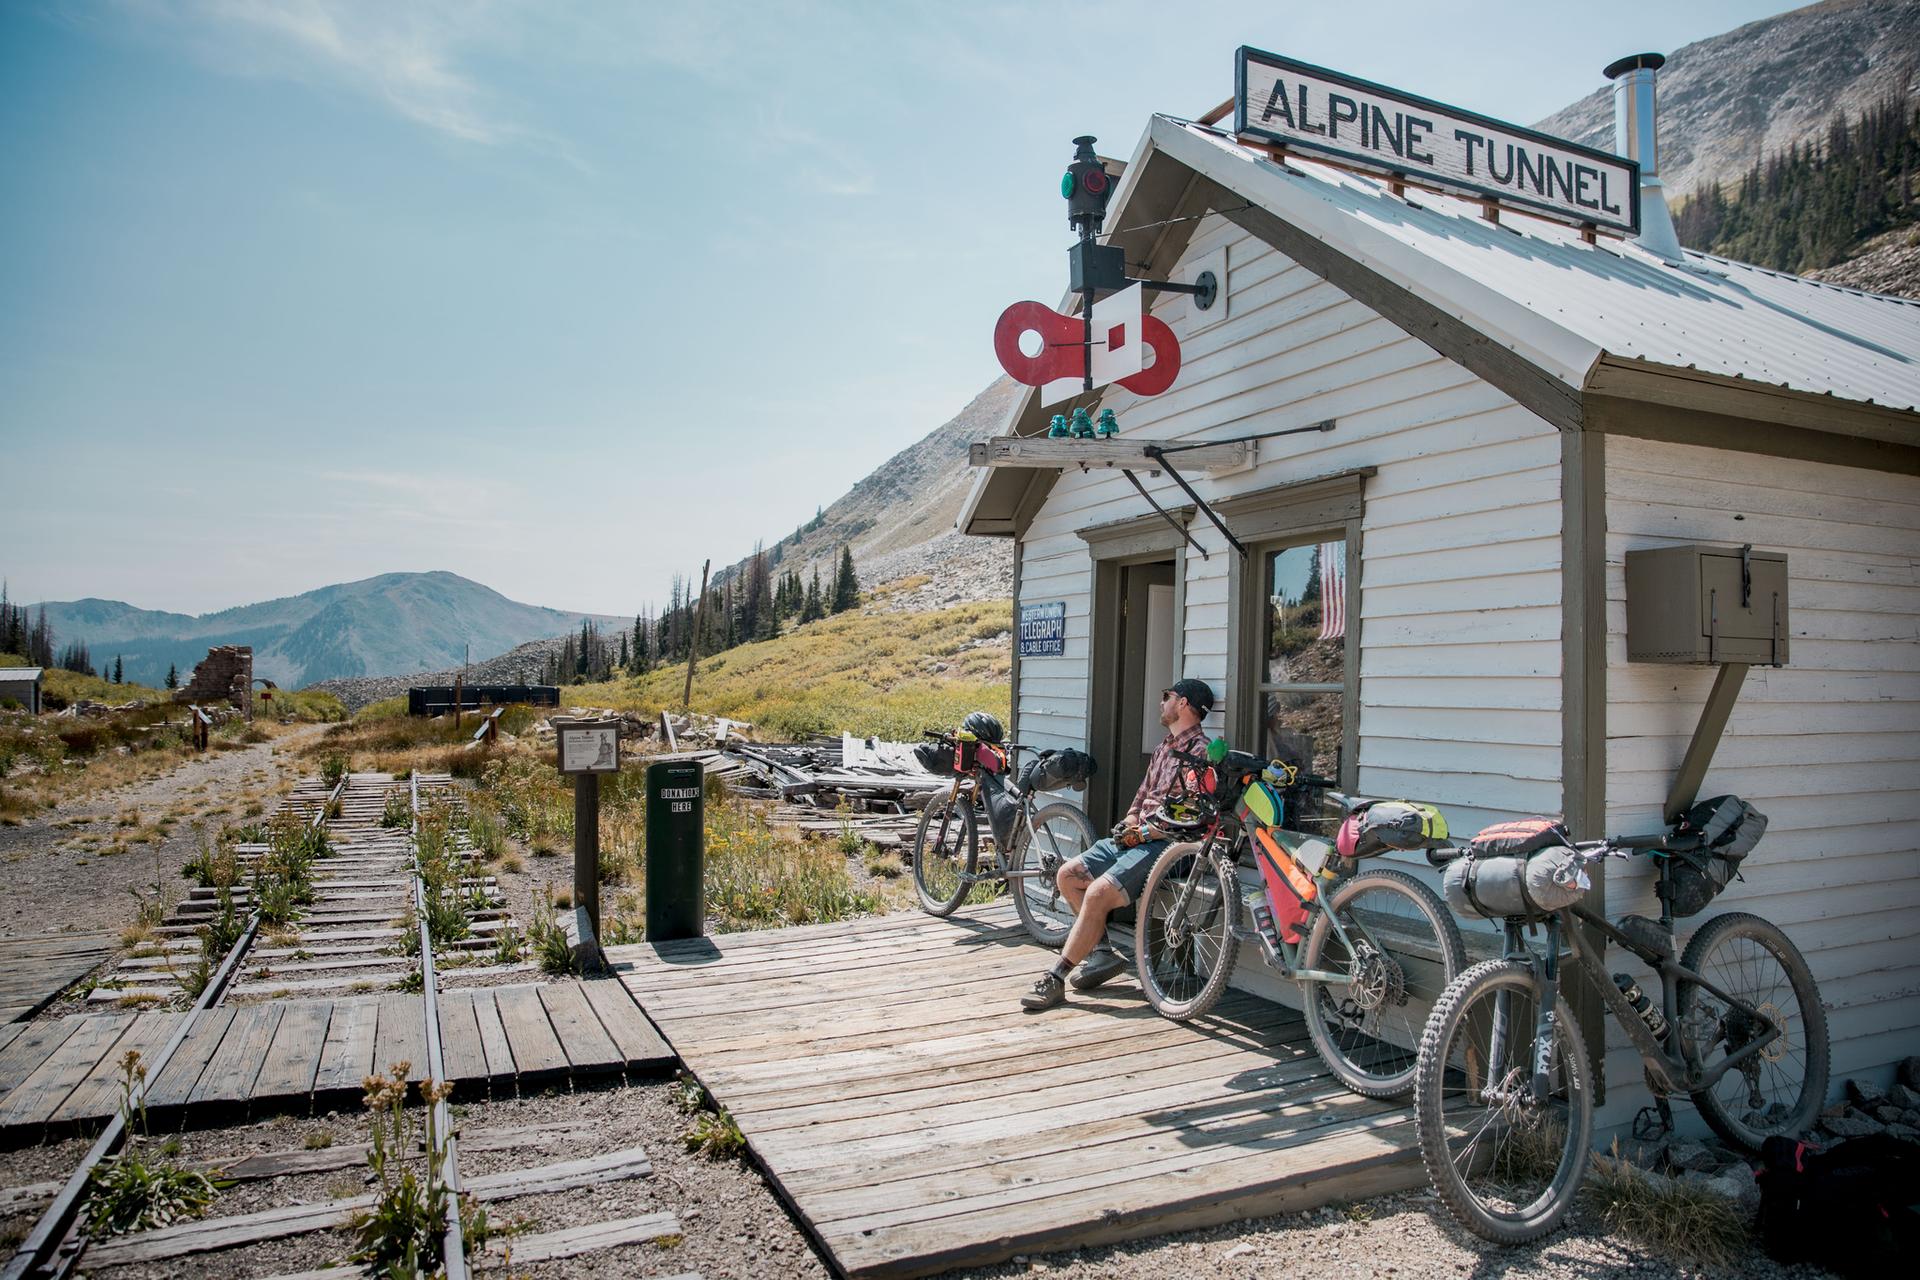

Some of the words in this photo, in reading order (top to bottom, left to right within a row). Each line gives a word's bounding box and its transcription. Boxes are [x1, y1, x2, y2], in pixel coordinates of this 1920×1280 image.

[1261, 78, 1434, 166] ALPINE
[1454, 129, 1621, 216] TUNNEL
[1021, 619, 1062, 640] TELEGRAPH
[1026, 640, 1042, 653] CABLE
[1042, 639, 1061, 652] OFFICE
[672, 802, 691, 812] HERE
[1536, 1036, 1553, 1075] FOX
[1568, 1052, 1578, 1075] SWISS
[1573, 1076, 1580, 1090] DT
